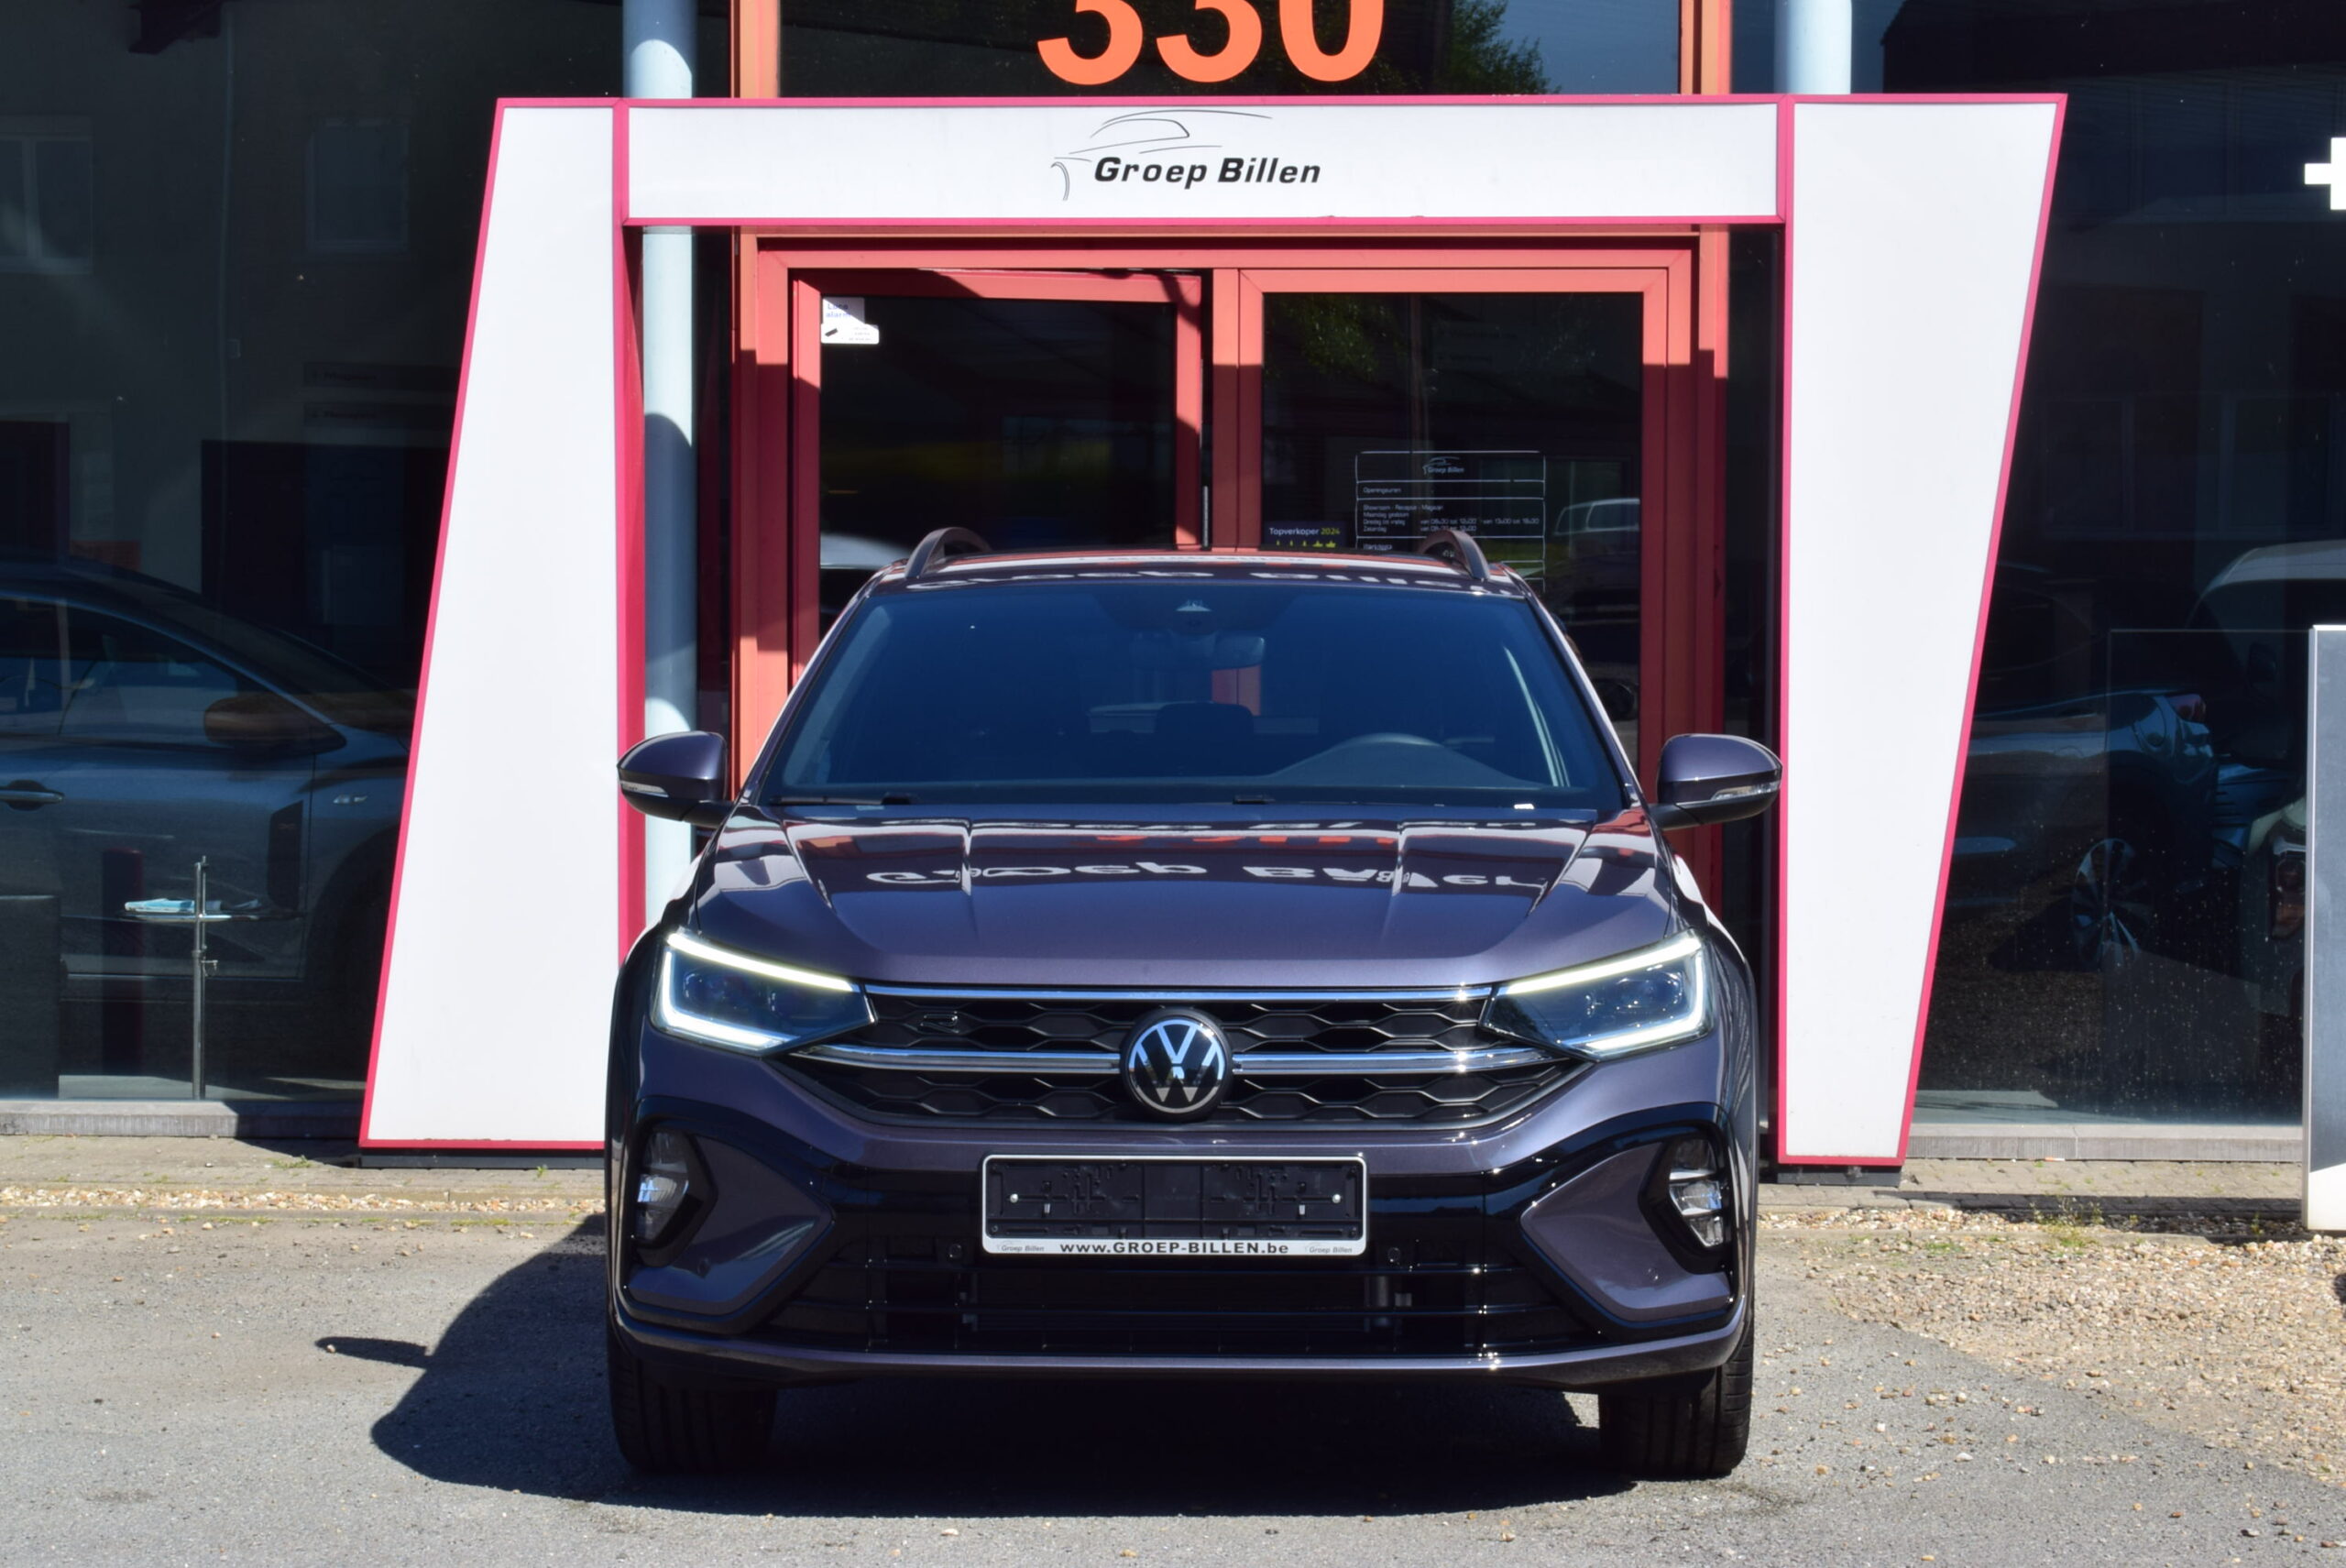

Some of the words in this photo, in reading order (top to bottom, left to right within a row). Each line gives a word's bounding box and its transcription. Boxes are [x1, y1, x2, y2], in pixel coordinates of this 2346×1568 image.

[1094, 157, 1207, 190] Groep
[1218, 158, 1321, 184] Billen
[1269, 527, 1320, 537] Topverkoper
[1001, 1245, 1023, 1253] Groep
[1025, 1245, 1045, 1253] Billen
[1059, 1242, 1289, 1255] www.GROEP-BILLEN.be
[1309, 1246, 1330, 1255] Groep
